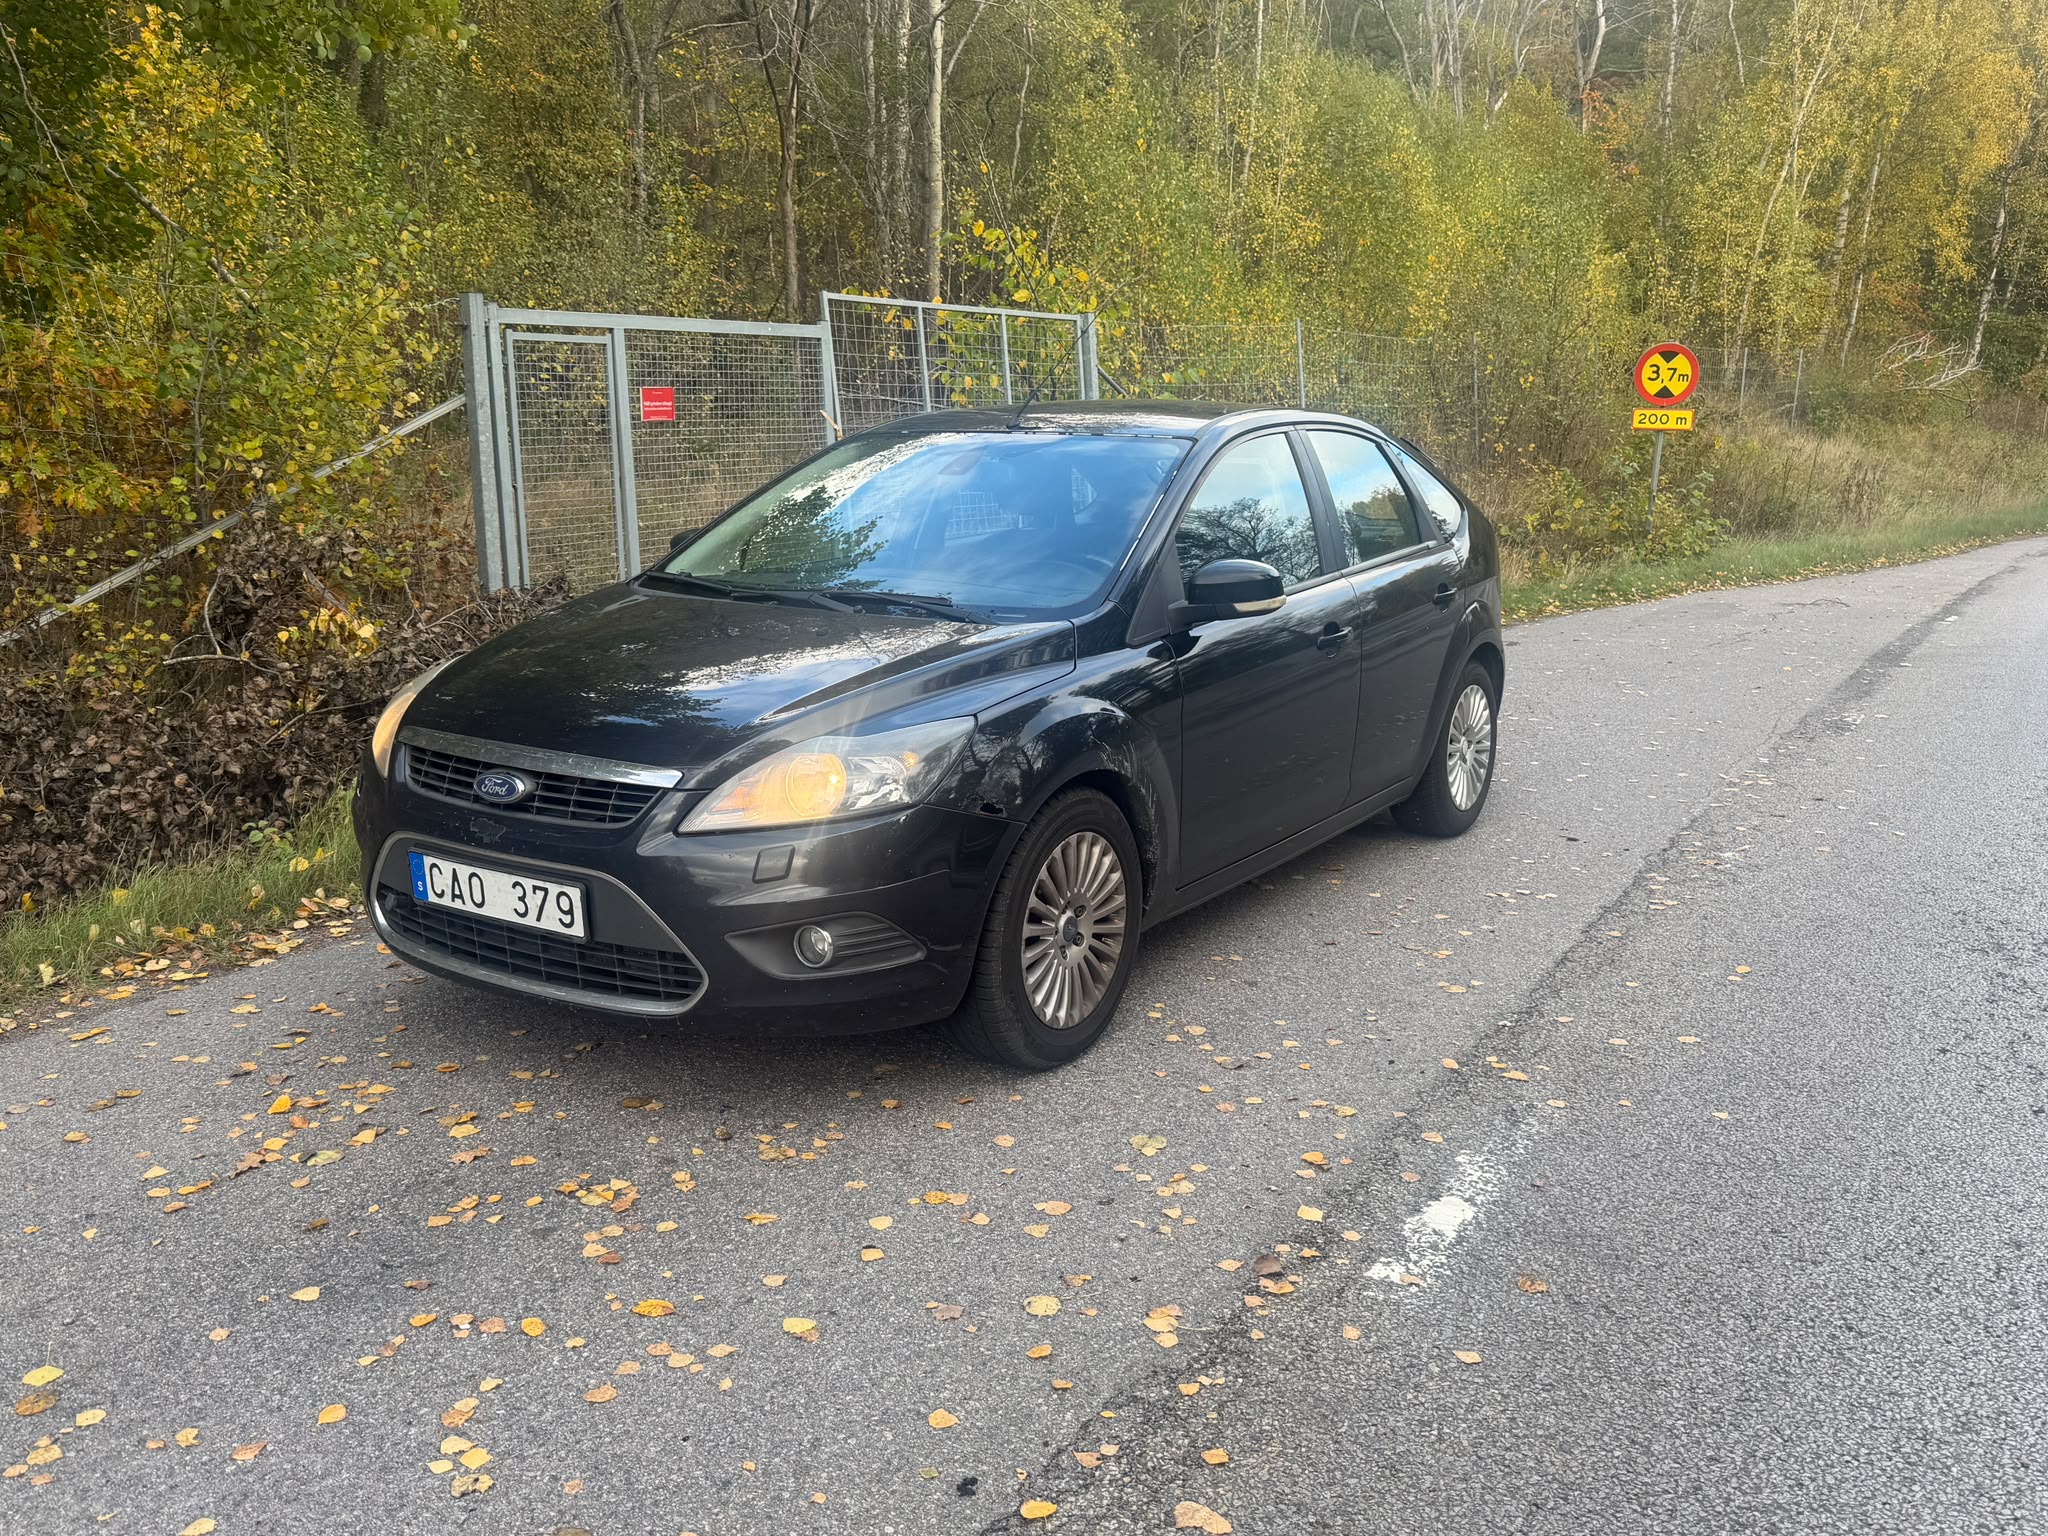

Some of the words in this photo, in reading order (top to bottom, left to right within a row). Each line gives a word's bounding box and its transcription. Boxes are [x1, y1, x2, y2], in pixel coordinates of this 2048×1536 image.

[1638, 413, 1669, 425] 200
[1676, 416, 1687, 425] m
[481, 777, 509, 795] Ford
[417, 880, 424, 891] S
[429, 862, 486, 909] CAO
[511, 880, 575, 929] 379
